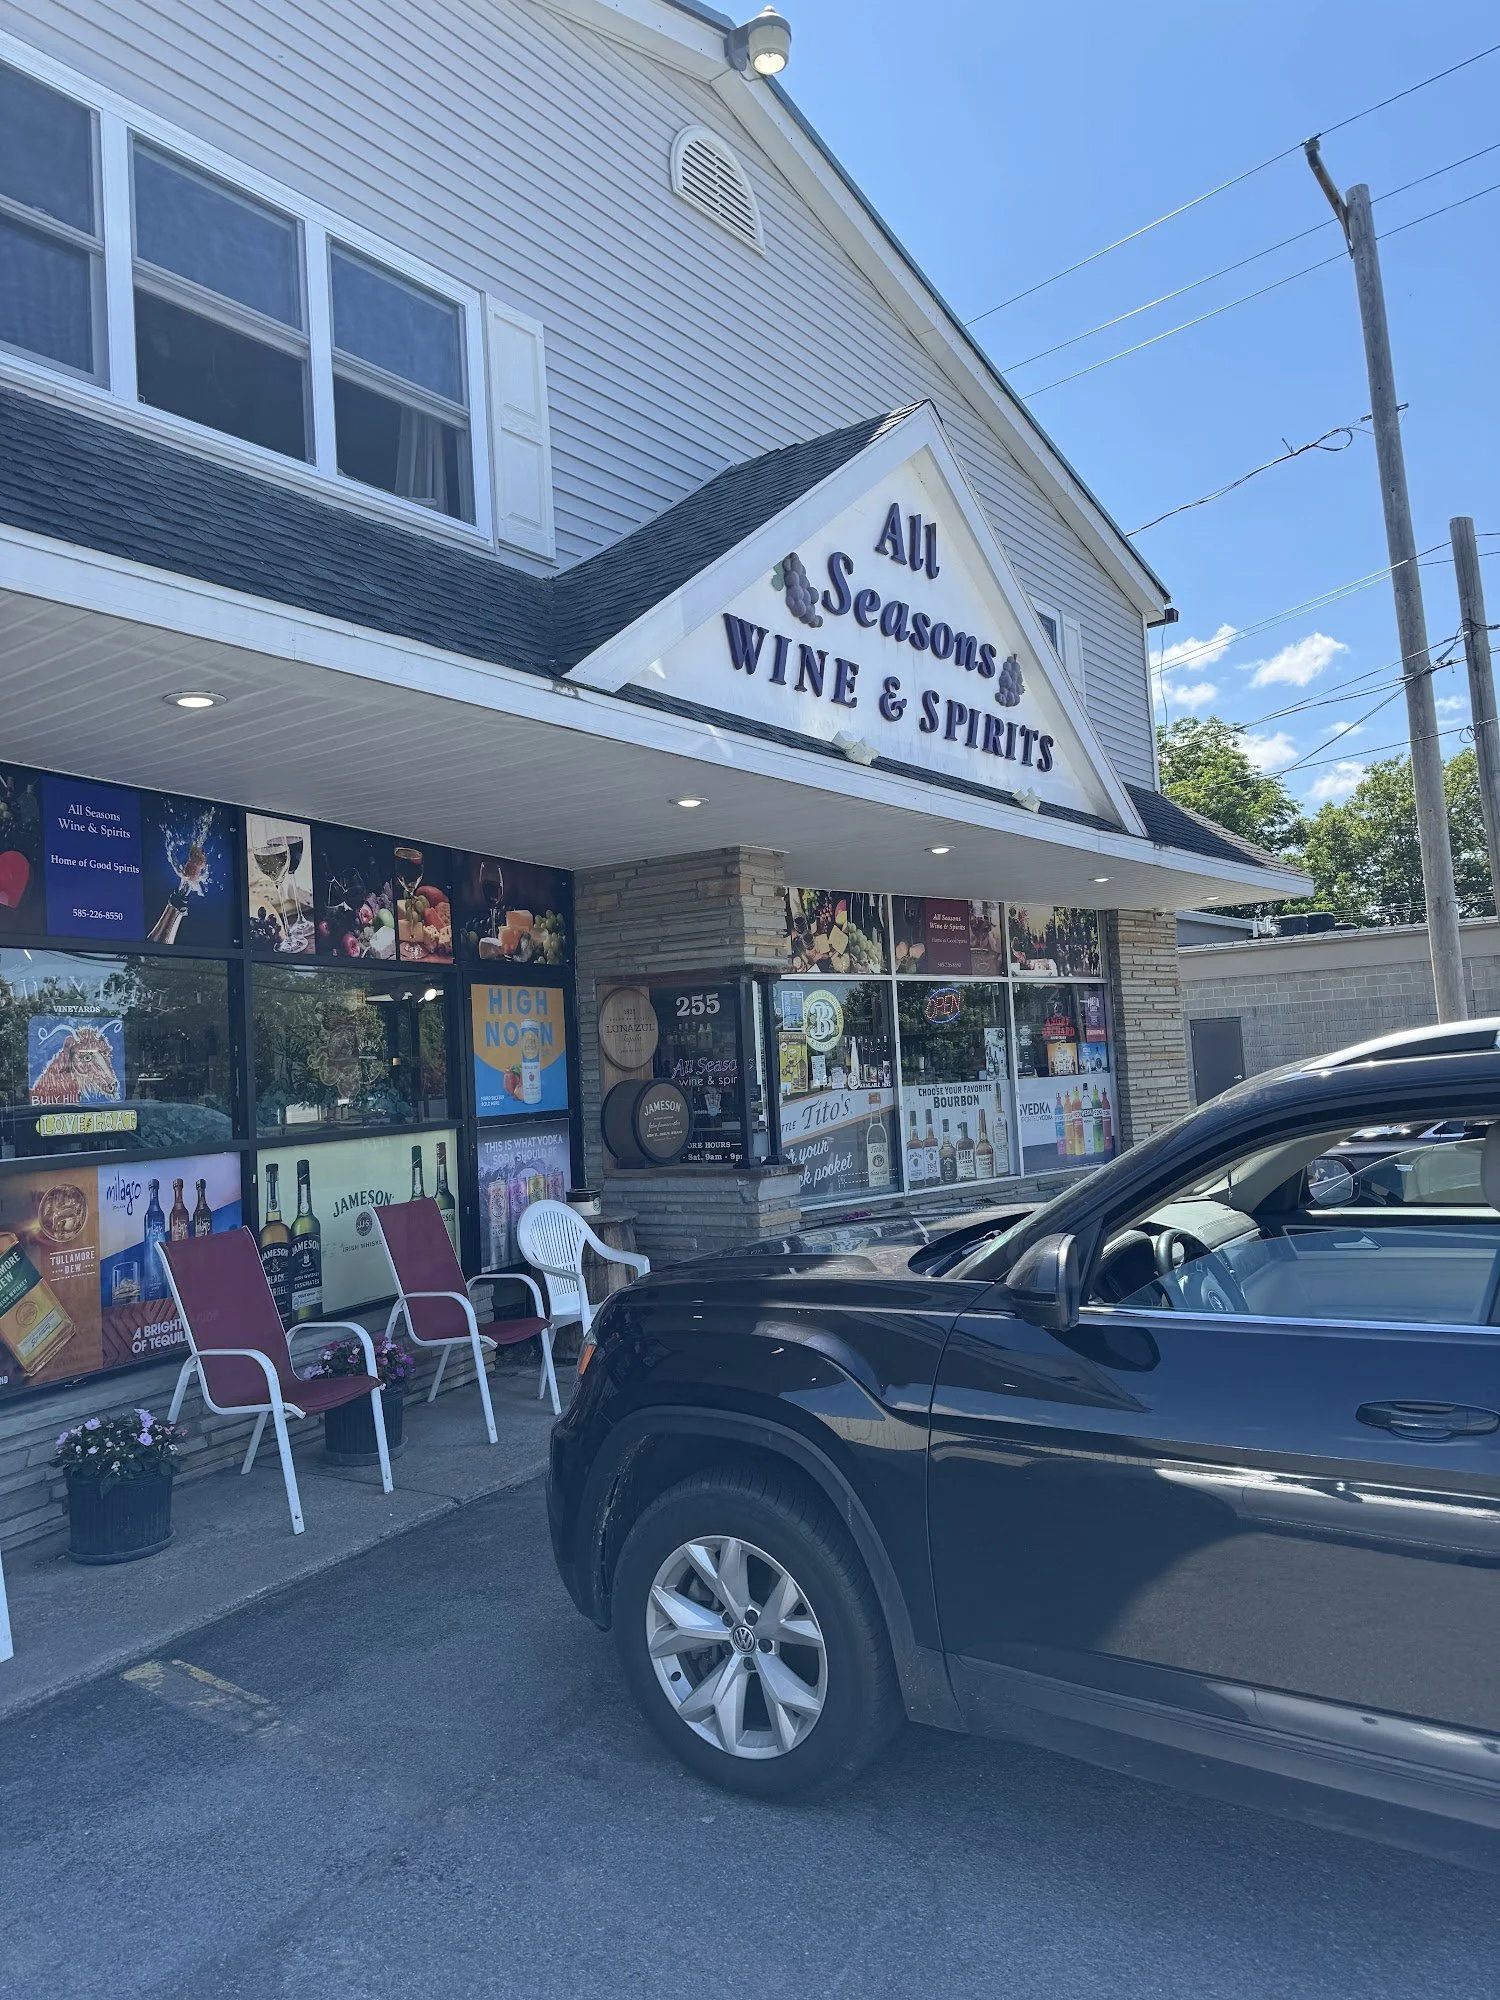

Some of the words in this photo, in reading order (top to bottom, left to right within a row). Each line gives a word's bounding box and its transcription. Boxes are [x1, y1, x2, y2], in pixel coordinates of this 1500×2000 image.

[874, 502, 940, 580] All
[821, 551, 997, 679] Seasons
[722, 612, 860, 709] WINE
[879, 675, 907, 722] &
[919, 689, 1054, 773] SPIRITS
[67, 803, 83, 816] All
[85, 806, 121, 822] Seasons
[58, 817, 86, 832] Wine
[88, 822, 98, 834] &
[100, 824, 131, 839] Spirits
[50, 854, 77, 866] Home
[78, 858, 88, 868] of
[89, 859, 112, 871] Good
[113, 862, 140, 875] Spirits
[72, 908, 124, 921] 585-226-8550
[932, 913, 940, 921] All
[941, 914, 962, 922] Seasons
[929, 922, 942, 930] Wine
[949, 924, 966, 932] Spirits
[53, 1005, 101, 1014] VINEYARDS
[488, 987, 549, 1016] HIGH
[675, 992, 721, 1017] 255
[925, 991, 962, 1019] OPEN
[485, 1021, 554, 1048] NON
[606, 1023, 656, 1034] LUNAZUL
[672, 1058, 694, 1080] All
[679, 1077, 704, 1087] wine
[707, 1075, 715, 1086] &
[718, 1074, 738, 1087] spir
[918, 1087, 944, 1097] CHOOSE
[944, 1085, 963, 1095] YOUR
[963, 1083, 992, 1094] FAVORITE
[31, 1095, 62, 1107] BULLY
[63, 1093, 81, 1104] HILL
[644, 1100, 681, 1117] JAMESON
[933, 1094, 980, 1109] BOURBON
[1020, 1102, 1052, 1116] SVEDKA
[781, 1120, 797, 1134] TTLE
[802, 1093, 852, 1130] Tito's
[41, 1114, 86, 1136] LOVE
[484, 1141, 503, 1154] THIS
[504, 1139, 513, 1151] IS
[513, 1137, 537, 1149] WHAT
[537, 1134, 564, 1146] VODKA
[704, 1141, 731, 1149] HOURS
[799, 1139, 830, 1165] your
[492, 1153, 516, 1167] SODA
[516, 1148, 547, 1162] SHOULD
[687, 1153, 704, 1161] Sat.
[705, 1153, 723, 1161] 9am
[813, 1151, 853, 1189] pocket
[333, 1189, 393, 1218] JAMESON
[291, 1239, 320, 1257] JAMESON
[342, 1244, 360, 1253] IRISH
[360, 1239, 383, 1249] WHISKE
[50, 1250, 95, 1266] TULLAMORE
[261, 1248, 289, 1263] JAMESON
[64, 1263, 82, 1275] DEW
[131, 1340, 147, 1354] OF
[148, 1330, 188, 1350] TEQUIL
[132, 1327, 142, 1341] A
